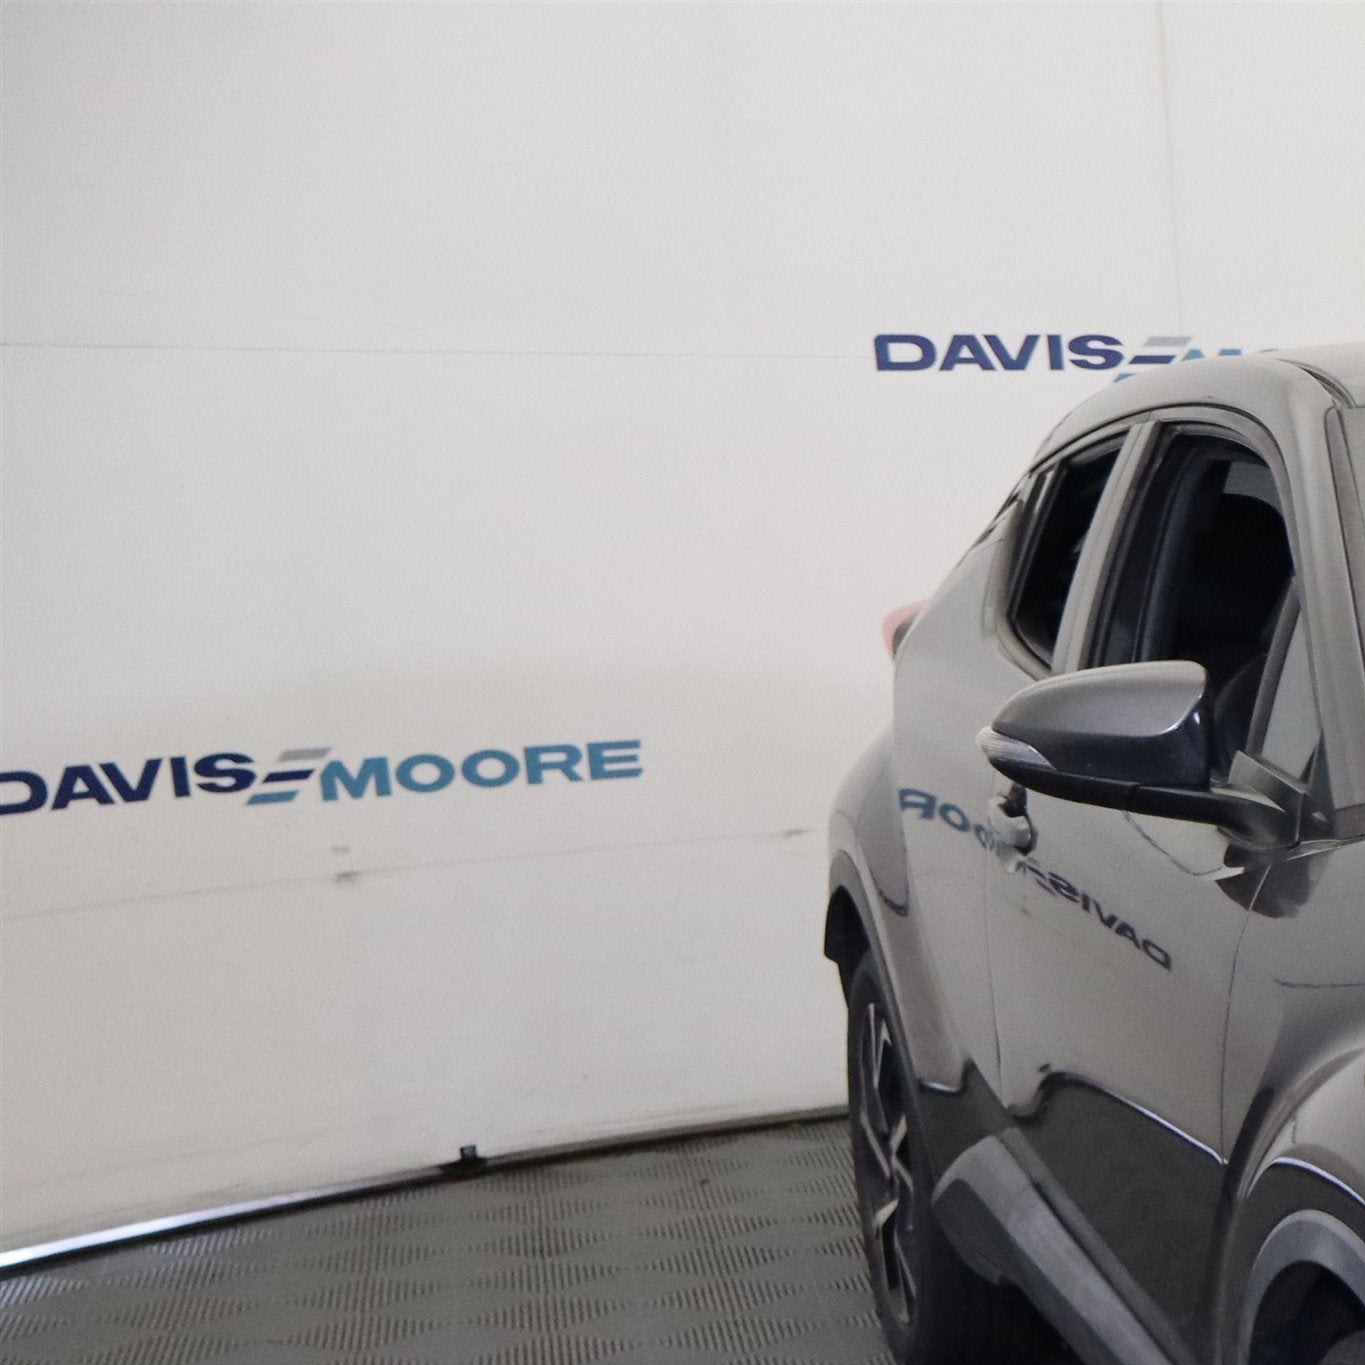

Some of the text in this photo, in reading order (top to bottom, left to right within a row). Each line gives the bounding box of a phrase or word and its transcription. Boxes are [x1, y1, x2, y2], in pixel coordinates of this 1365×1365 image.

[873, 333, 1126, 372] DAVIS
[0, 739, 645, 815] DAVIS MOORE
